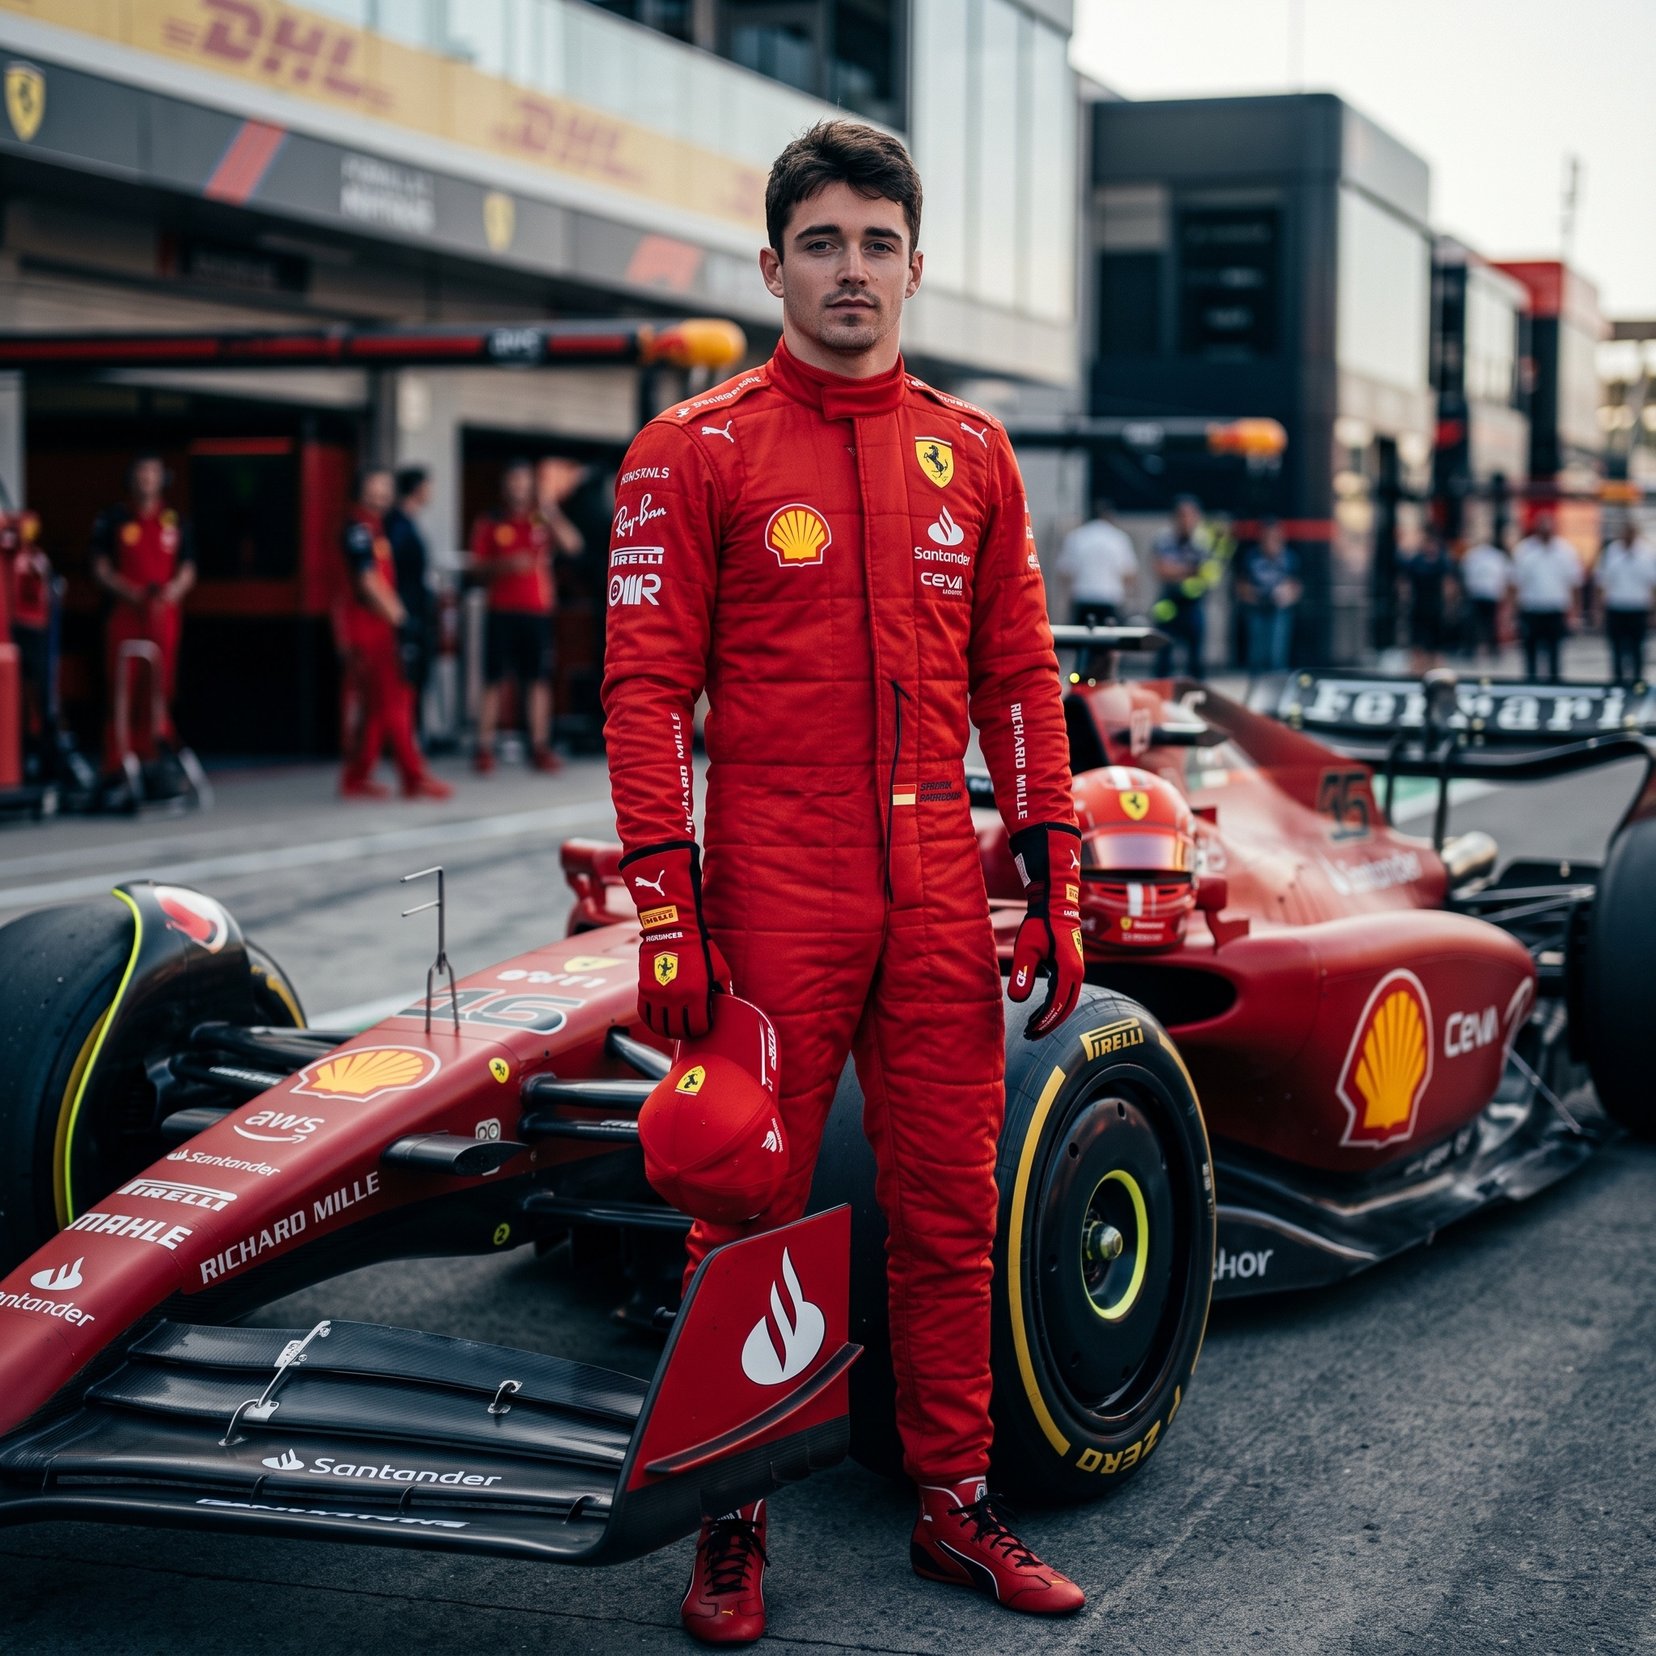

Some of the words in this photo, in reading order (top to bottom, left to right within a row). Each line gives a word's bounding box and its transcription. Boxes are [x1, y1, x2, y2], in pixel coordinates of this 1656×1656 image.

[203, 0, 362, 97] DHL
[610, 546, 665, 568] PIRELLI
[914, 546, 970, 566] Santander
[671, 712, 684, 759] MILLE
[1010, 702, 1026, 769] RICHARD
[1016, 774, 1028, 820] MILLE
[1079, 1017, 1144, 1062] PIRELLI
[245, 1110, 325, 1135] aws
[186, 1152, 281, 1177] Santander
[115, 1178, 238, 1212] PIRELLI
[66, 1213, 193, 1251] MAHLE
[200, 1210, 306, 1285] RICHARD
[313, 1171, 381, 1224] MILLE
[0, 1291, 96, 1327] ntander
[1076, 1419, 1161, 1474] ZERO
[309, 1458, 502, 1487] Santander
